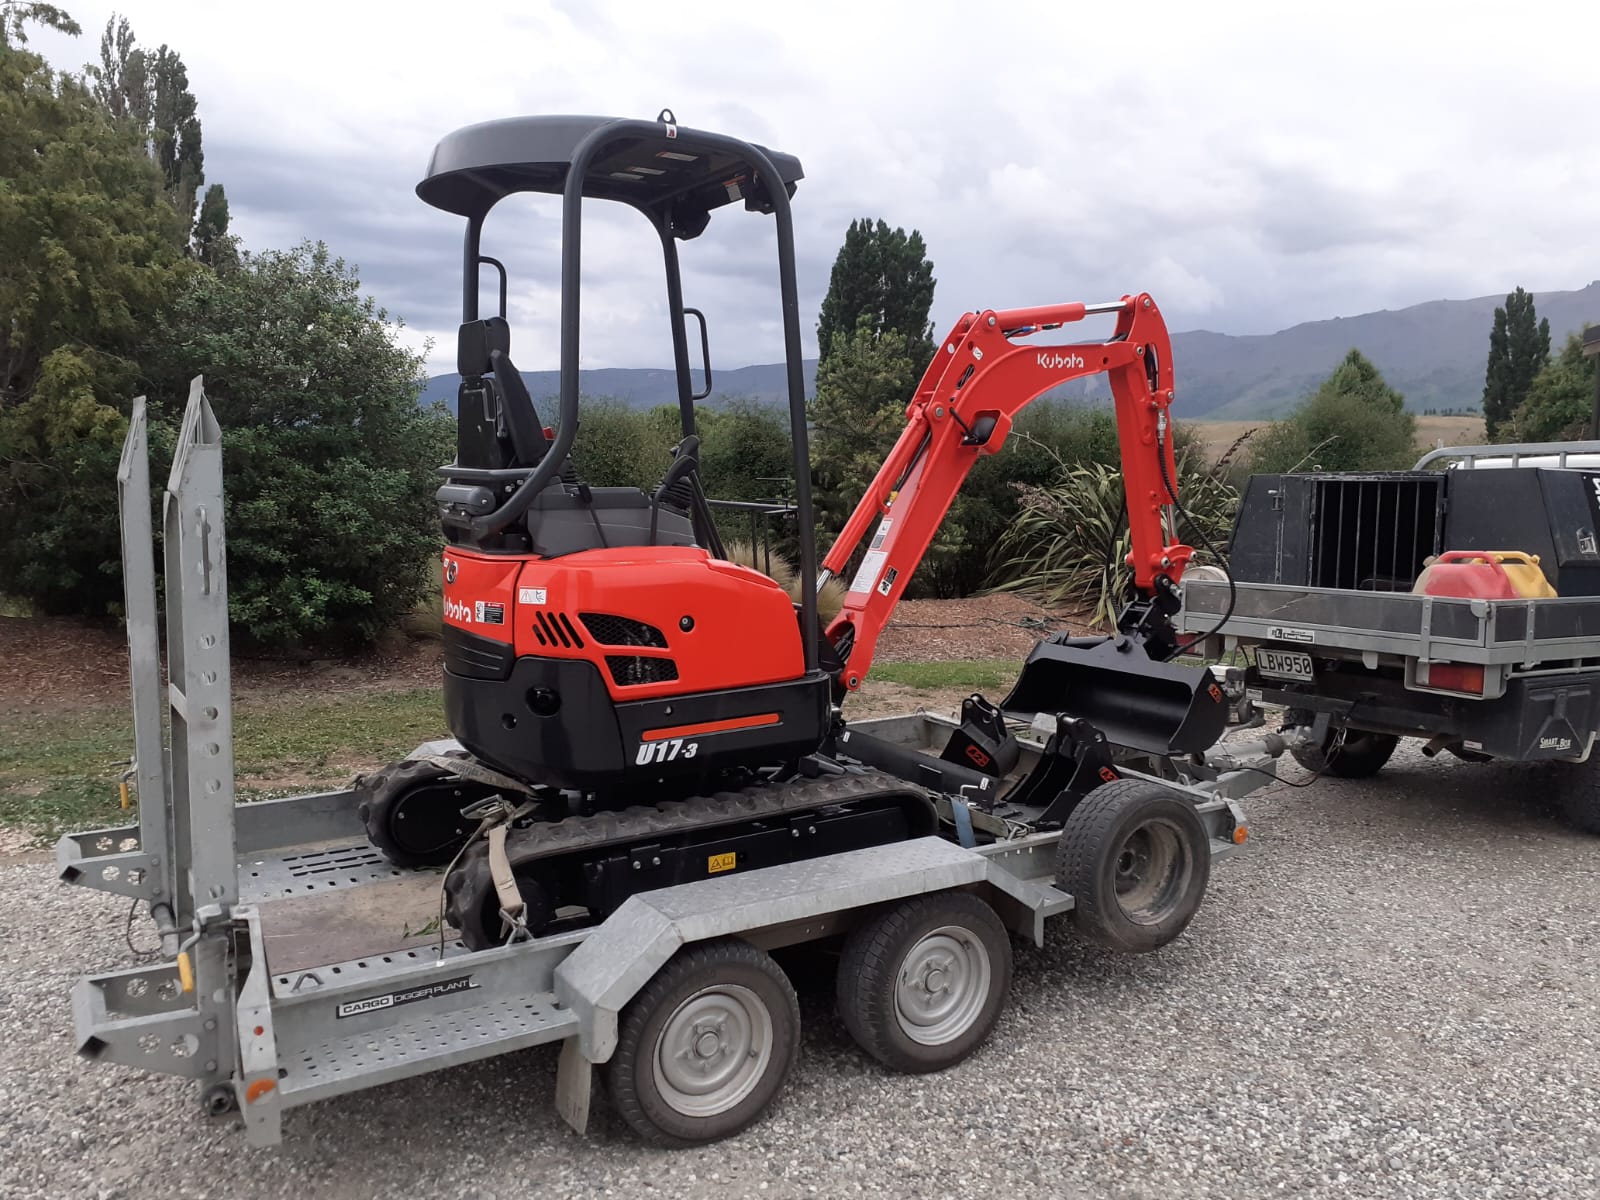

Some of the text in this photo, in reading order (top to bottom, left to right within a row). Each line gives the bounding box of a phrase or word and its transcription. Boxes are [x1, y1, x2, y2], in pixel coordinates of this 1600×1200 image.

[1037, 353, 1084, 369] Kubota
[443, 595, 472, 623] ubota
[1258, 653, 1312, 674] LBW950
[635, 739, 698, 766] U17-3
[343, 980, 468, 1014] CARGO DIGGER PLANT
